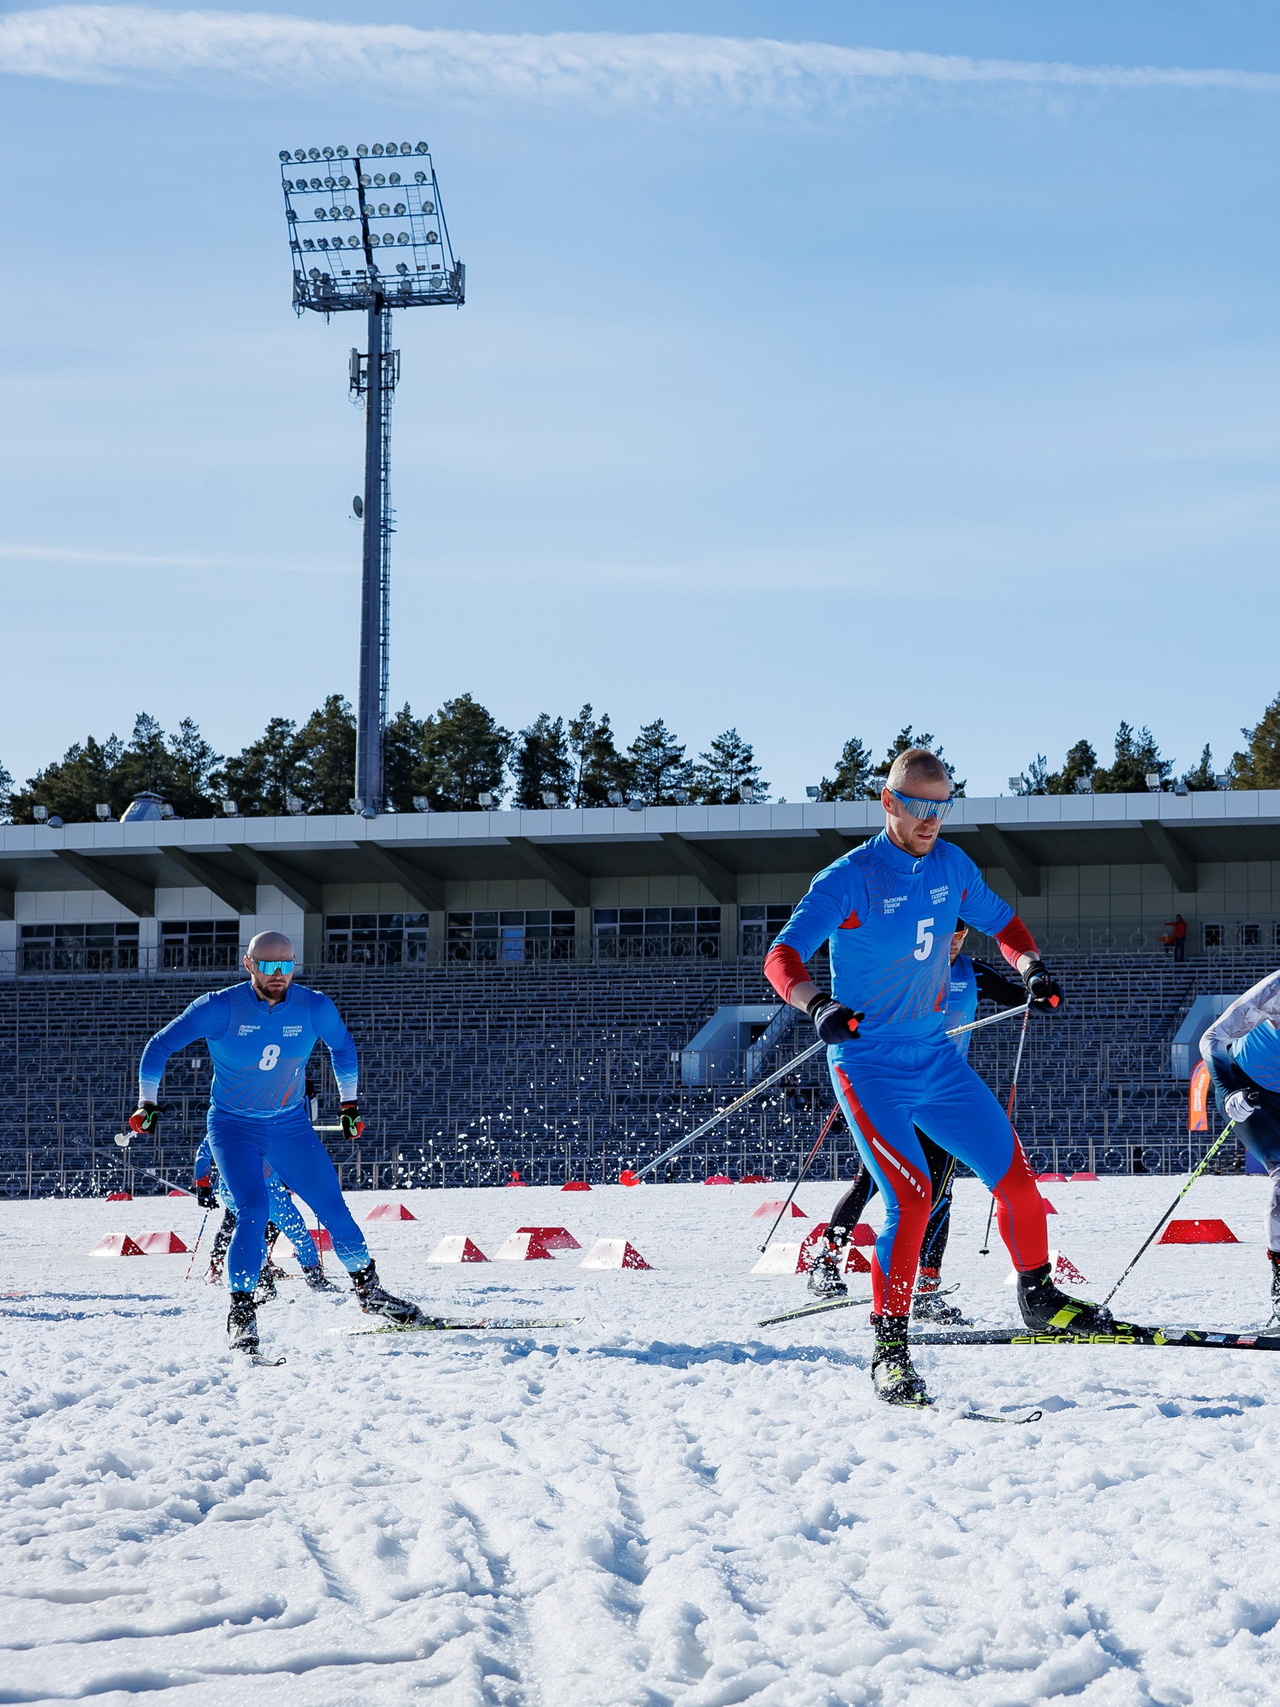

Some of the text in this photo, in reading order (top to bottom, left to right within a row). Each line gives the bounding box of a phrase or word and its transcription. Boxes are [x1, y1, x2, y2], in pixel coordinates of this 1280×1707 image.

[913, 917, 935, 961] 5
[258, 1044, 281, 1071] 8
[1011, 1335, 1136, 1344] FISCHER
